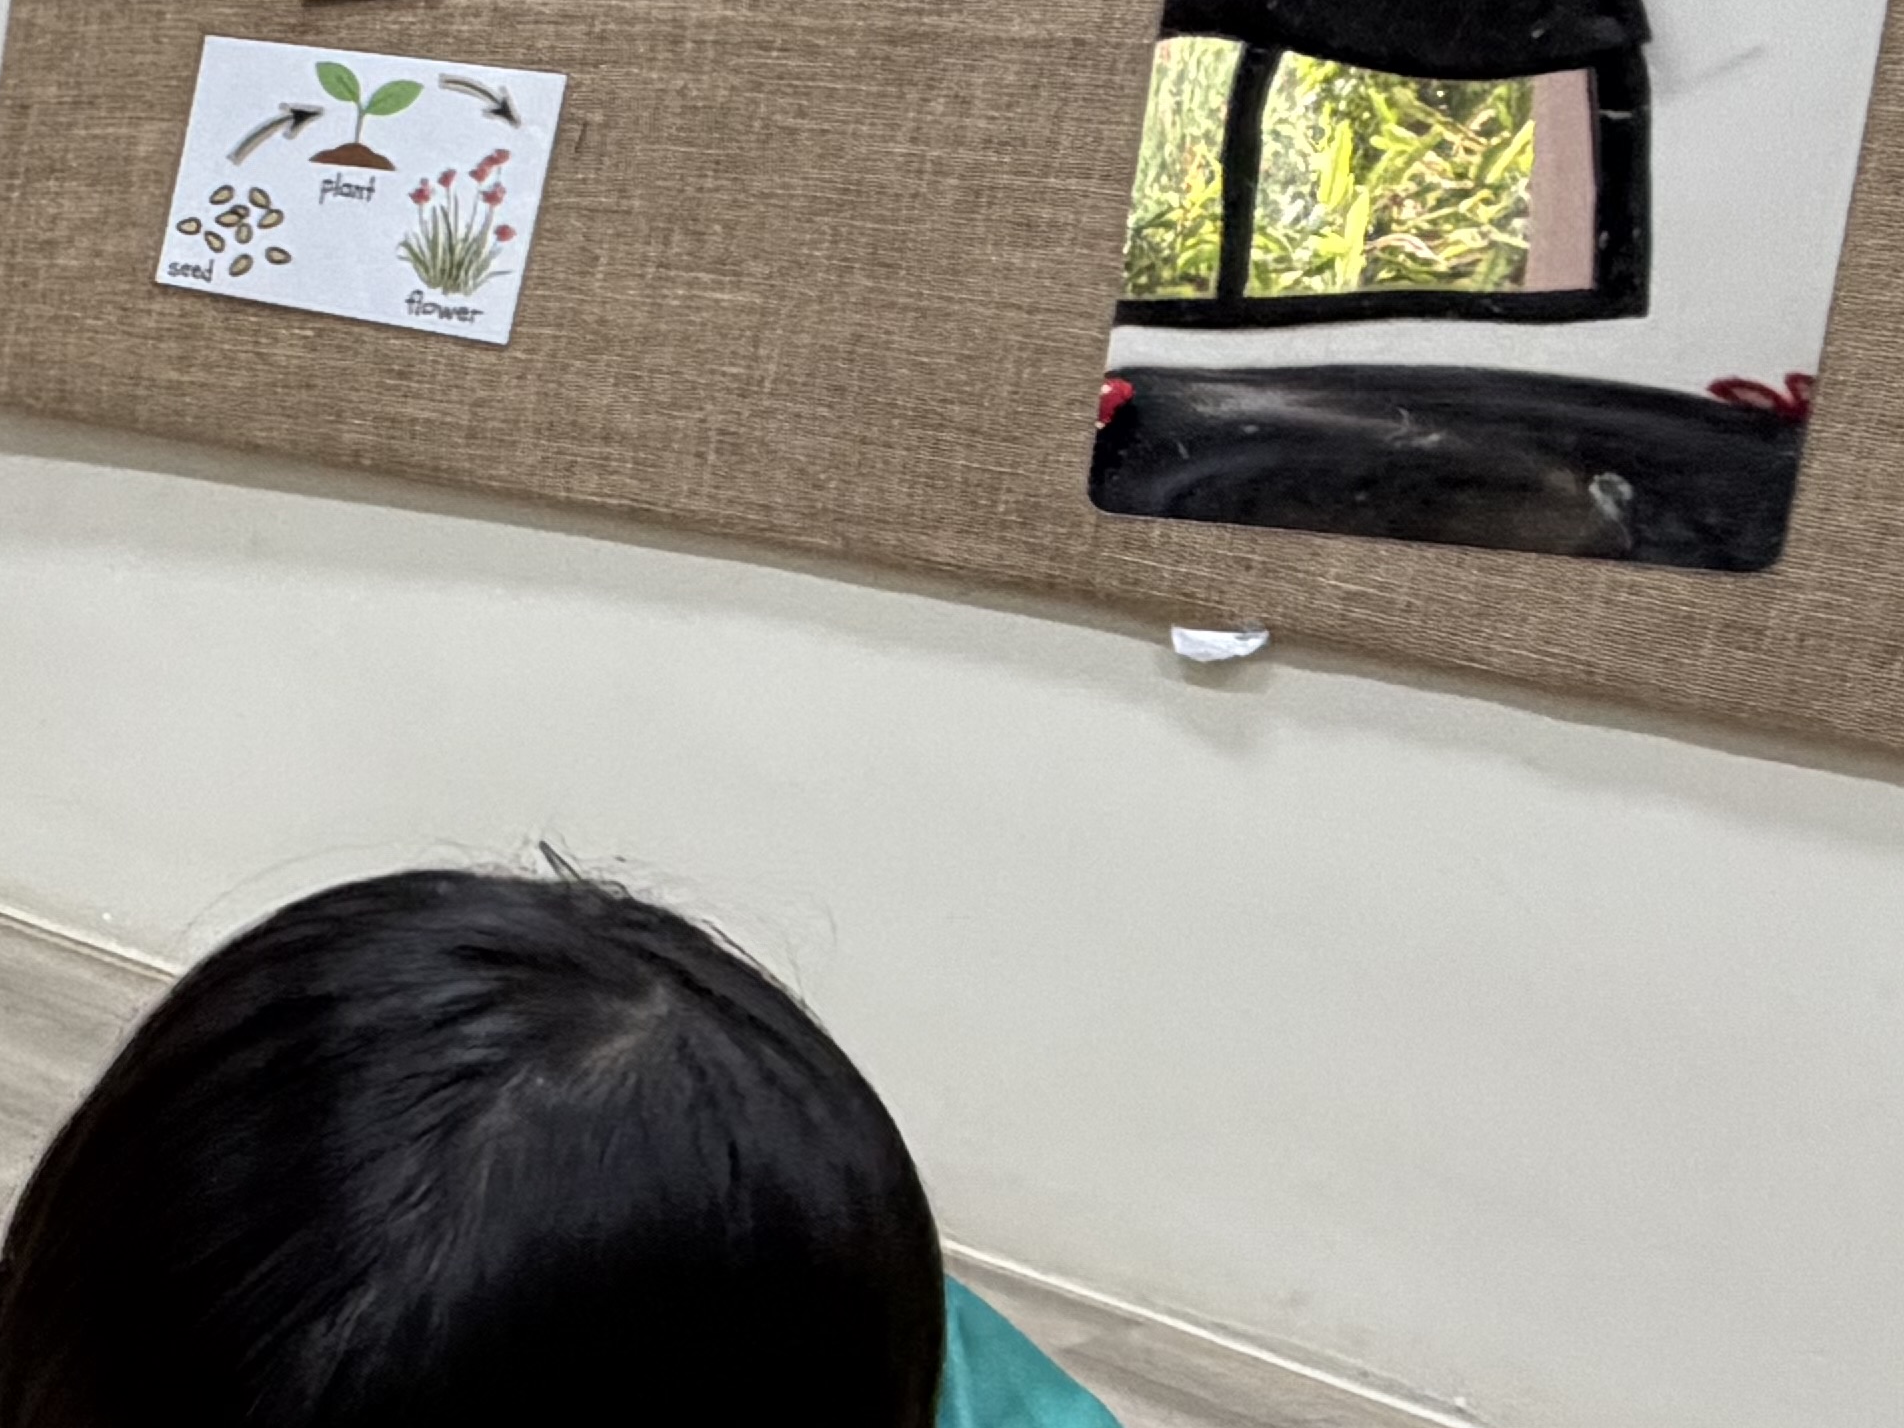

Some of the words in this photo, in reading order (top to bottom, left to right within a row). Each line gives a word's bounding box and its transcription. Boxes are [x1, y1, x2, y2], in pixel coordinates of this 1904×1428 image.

[319, 175, 376, 205] plant
[167, 258, 215, 282] seed
[405, 288, 484, 324] flower
